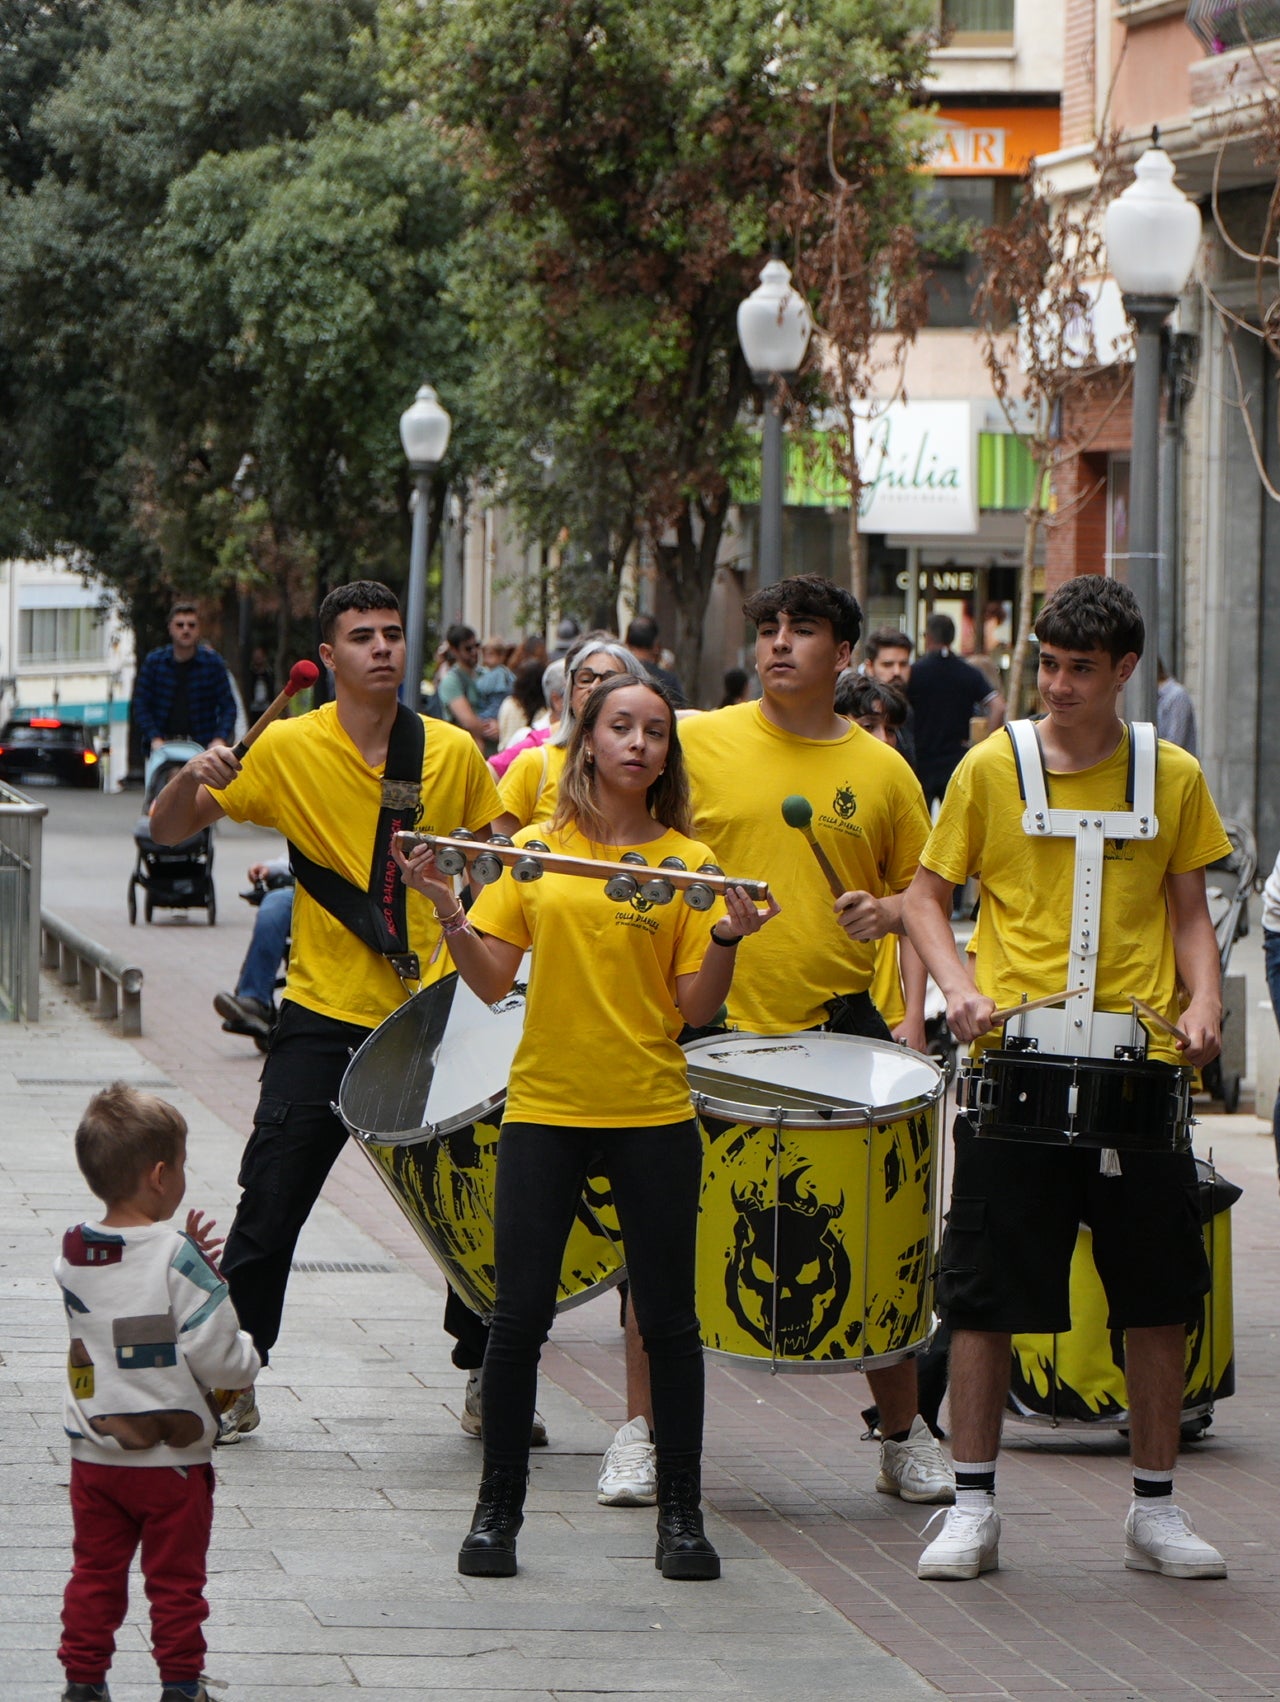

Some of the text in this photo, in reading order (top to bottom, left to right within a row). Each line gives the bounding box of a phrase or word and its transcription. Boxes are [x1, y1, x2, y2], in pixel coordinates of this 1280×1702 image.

[935, 131, 997, 165] AR
[857, 417, 959, 517] Júlia
[896, 570, 978, 591] CANE
[615, 911, 634, 920] COLLA
